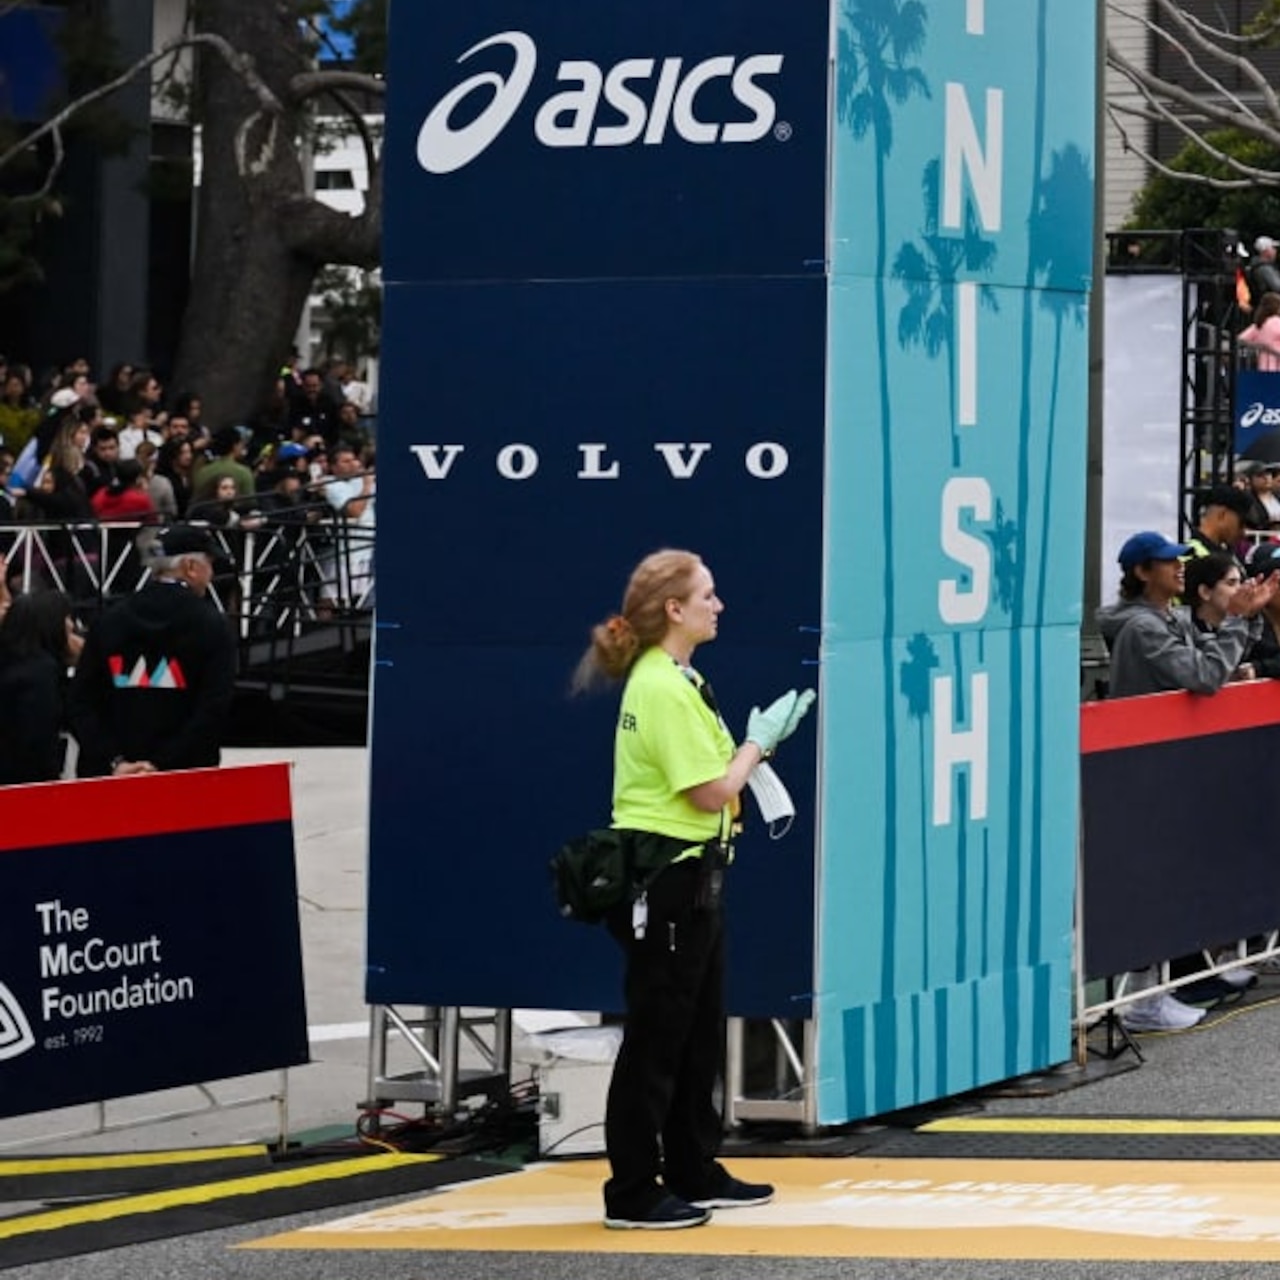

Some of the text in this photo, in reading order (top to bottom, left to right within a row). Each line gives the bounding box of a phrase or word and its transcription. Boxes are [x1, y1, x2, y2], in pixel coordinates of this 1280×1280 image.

[410, 442, 789, 480] VOLVO
[36, 899, 89, 935] The
[40, 935, 161, 979] McCourt
[42, 974, 194, 1021] Foundation
[44, 1025, 104, 1049] est. 1992
